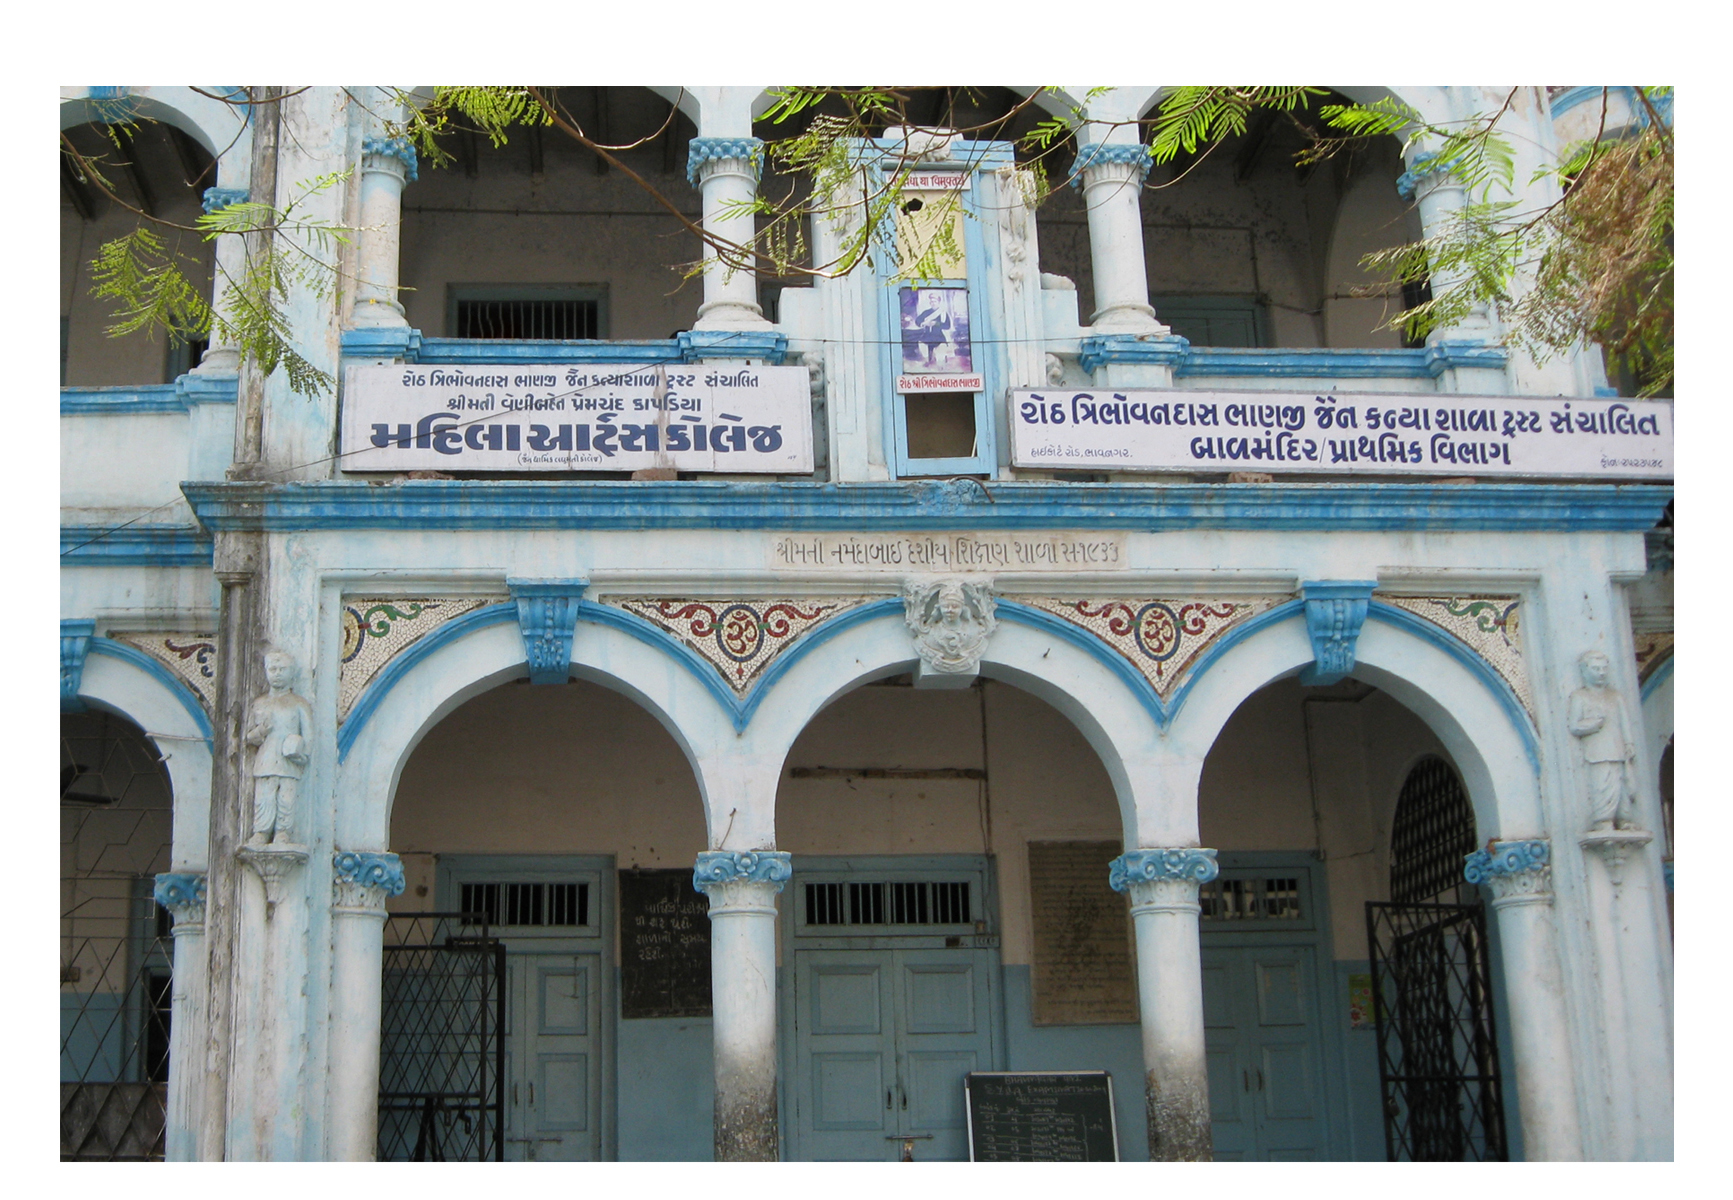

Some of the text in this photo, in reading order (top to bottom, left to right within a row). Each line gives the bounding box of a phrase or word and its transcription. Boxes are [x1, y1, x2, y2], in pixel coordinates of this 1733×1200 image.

[402, 369, 426, 387] શેઠ
[430, 369, 509, 388] ત્રિભોવનદાસ
[514, 374, 557, 388] ભાણજી
[565, 368, 588, 387] જૈન
[665, 374, 695, 390] ટ્રસ્ટ
[705, 370, 759, 388] સંચાલિત
[446, 394, 495, 412] શ્રીમતી
[570, 393, 624, 412] પ્રેમચંદ
[1020, 394, 1066, 425] શેઠ
[1071, 393, 1219, 426] ત્રિભોવનદાસ
[1224, 402, 1307, 431] ભાણજી
[1314, 395, 1358, 430] જૈન
[1501, 410, 1543, 439] ટ્રસ્ટ
[1549, 402, 1661, 437] સંચાલિત
[370, 413, 521, 455] મહિલા
[1430, 433, 1512, 465] વિભાગ
